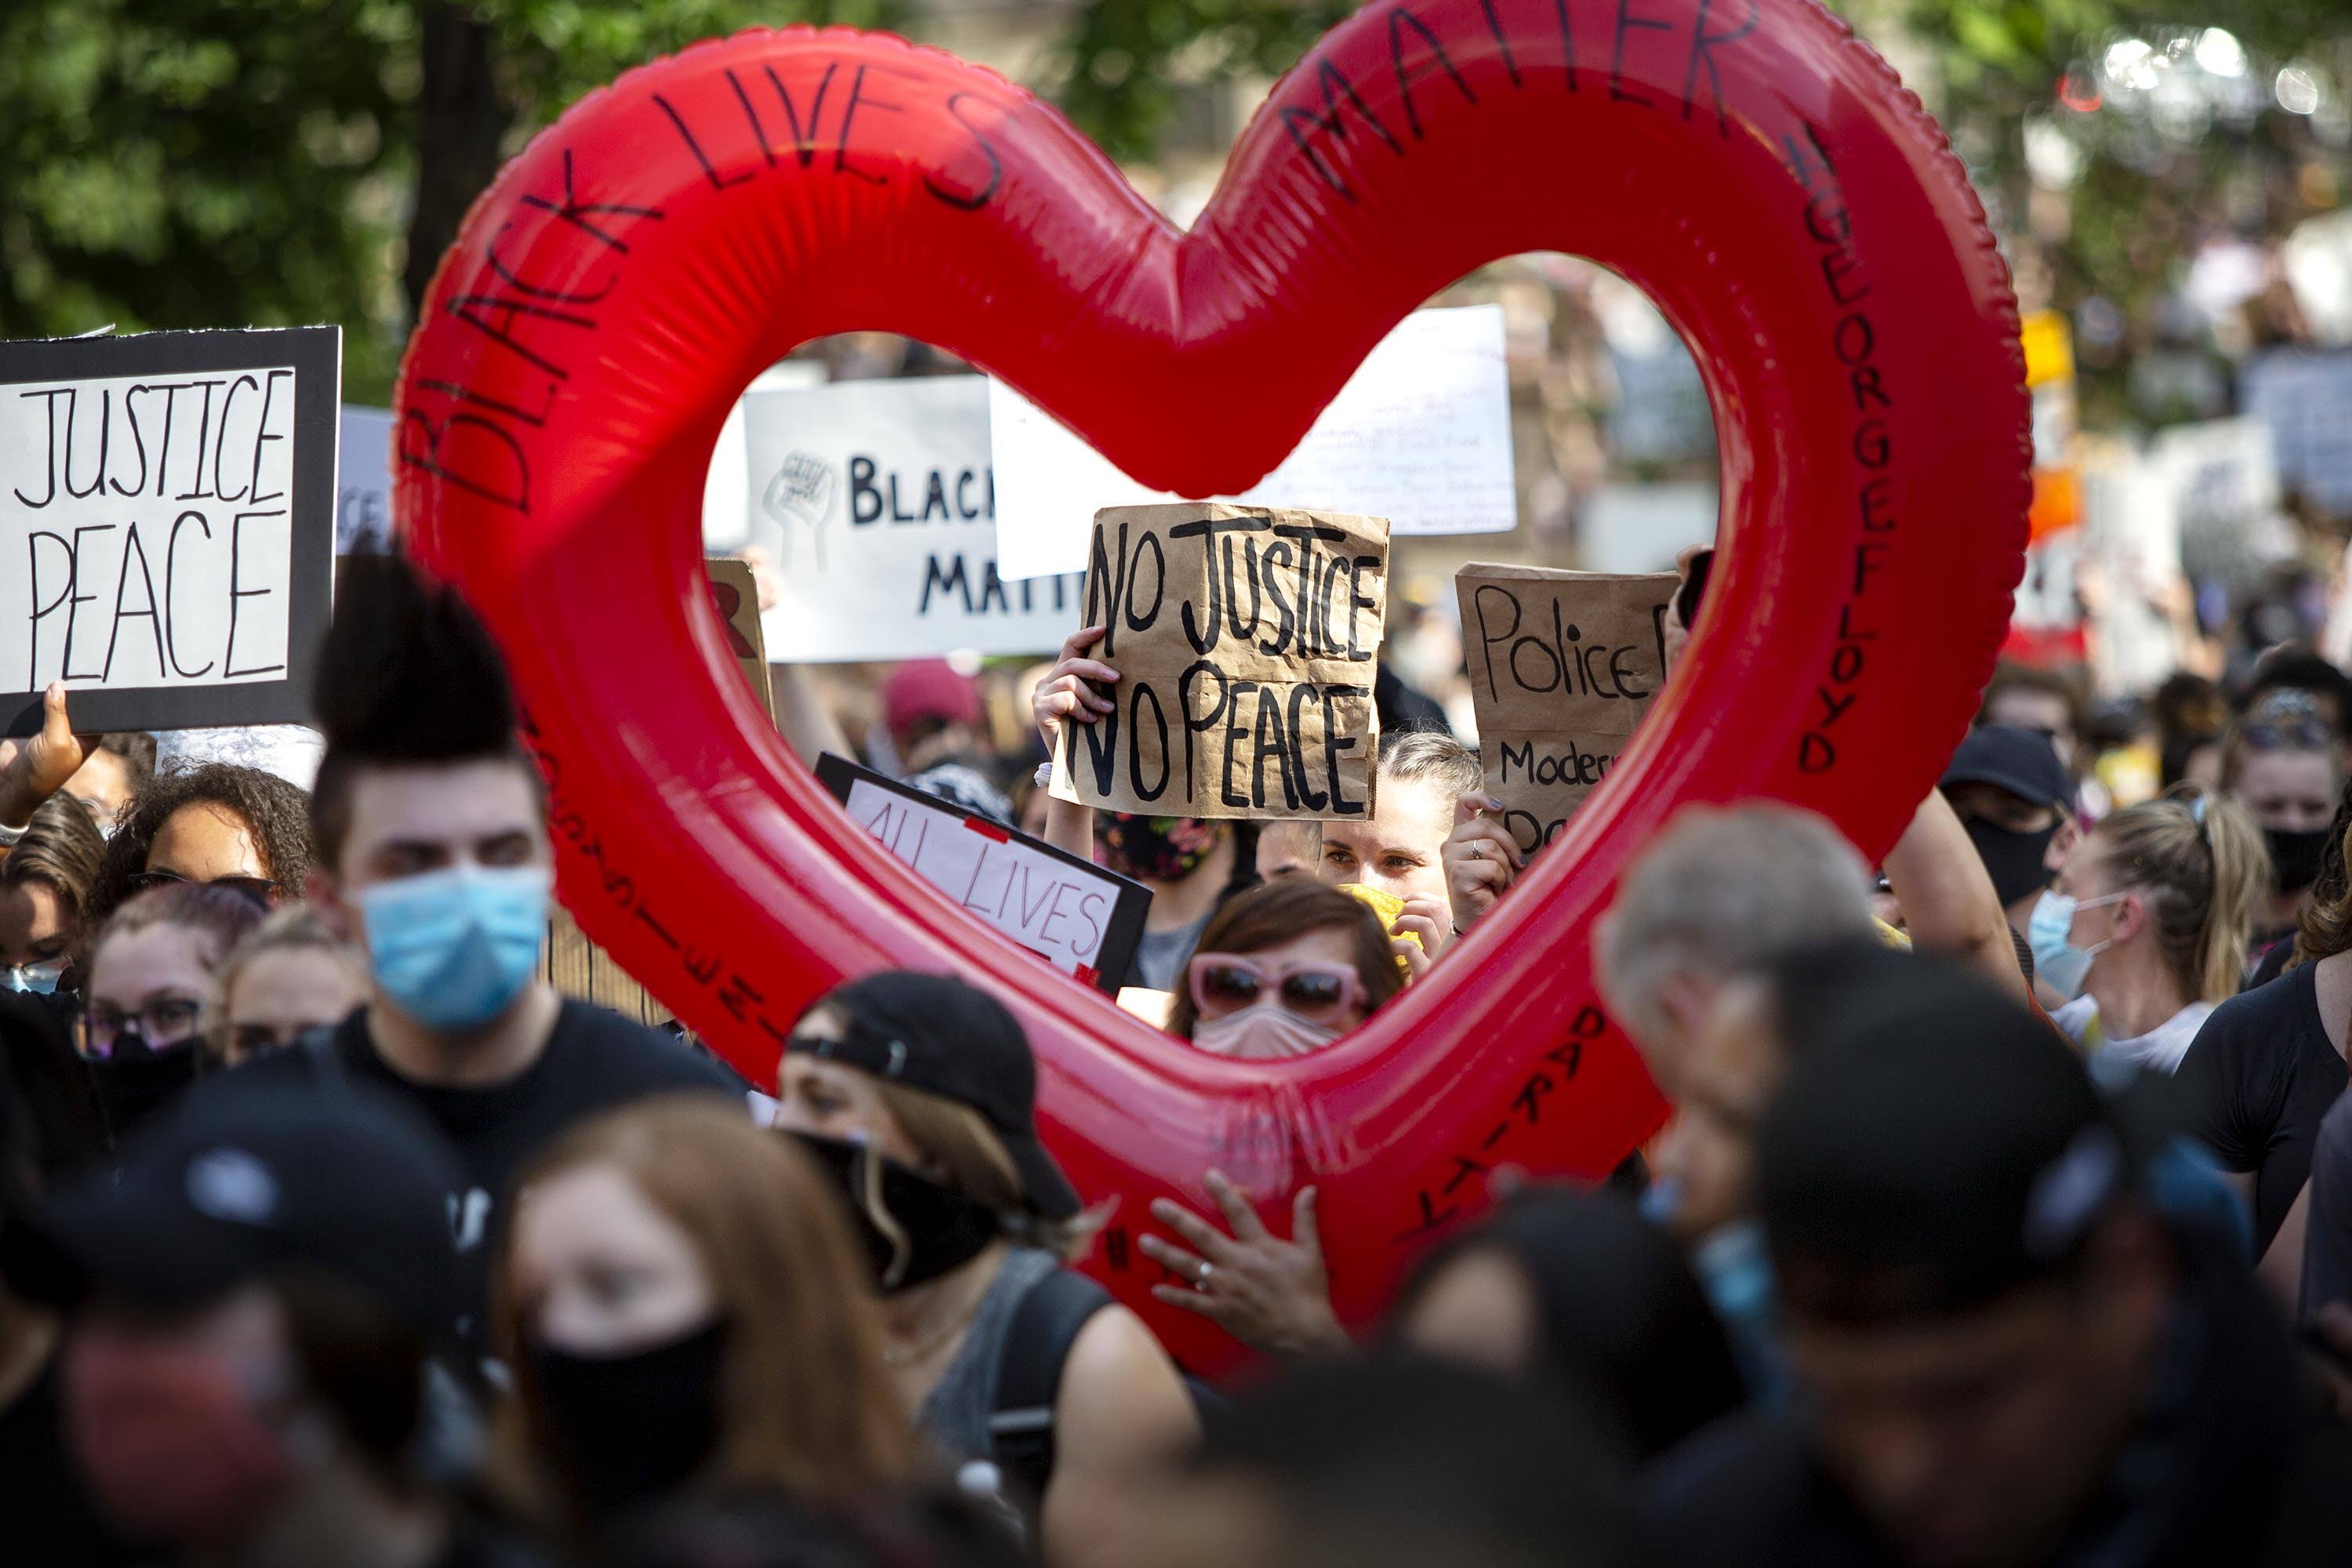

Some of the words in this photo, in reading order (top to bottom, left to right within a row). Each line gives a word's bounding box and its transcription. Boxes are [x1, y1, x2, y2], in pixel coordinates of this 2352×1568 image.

[399, 148, 666, 517] BLACK
[652, 63, 1014, 212] LIVES
[13, 370, 295, 510] JUSTICE
[849, 455, 995, 526] BLAC
[28, 509, 288, 693] PEACE
[1087, 522, 1167, 659] NO
[1169, 516, 1382, 662] JUSTICE
[1474, 584, 1650, 704] Police
[1066, 681, 1171, 803] NO
[1178, 659, 1370, 815] PEACE
[964, 842, 1105, 957] LIVES
